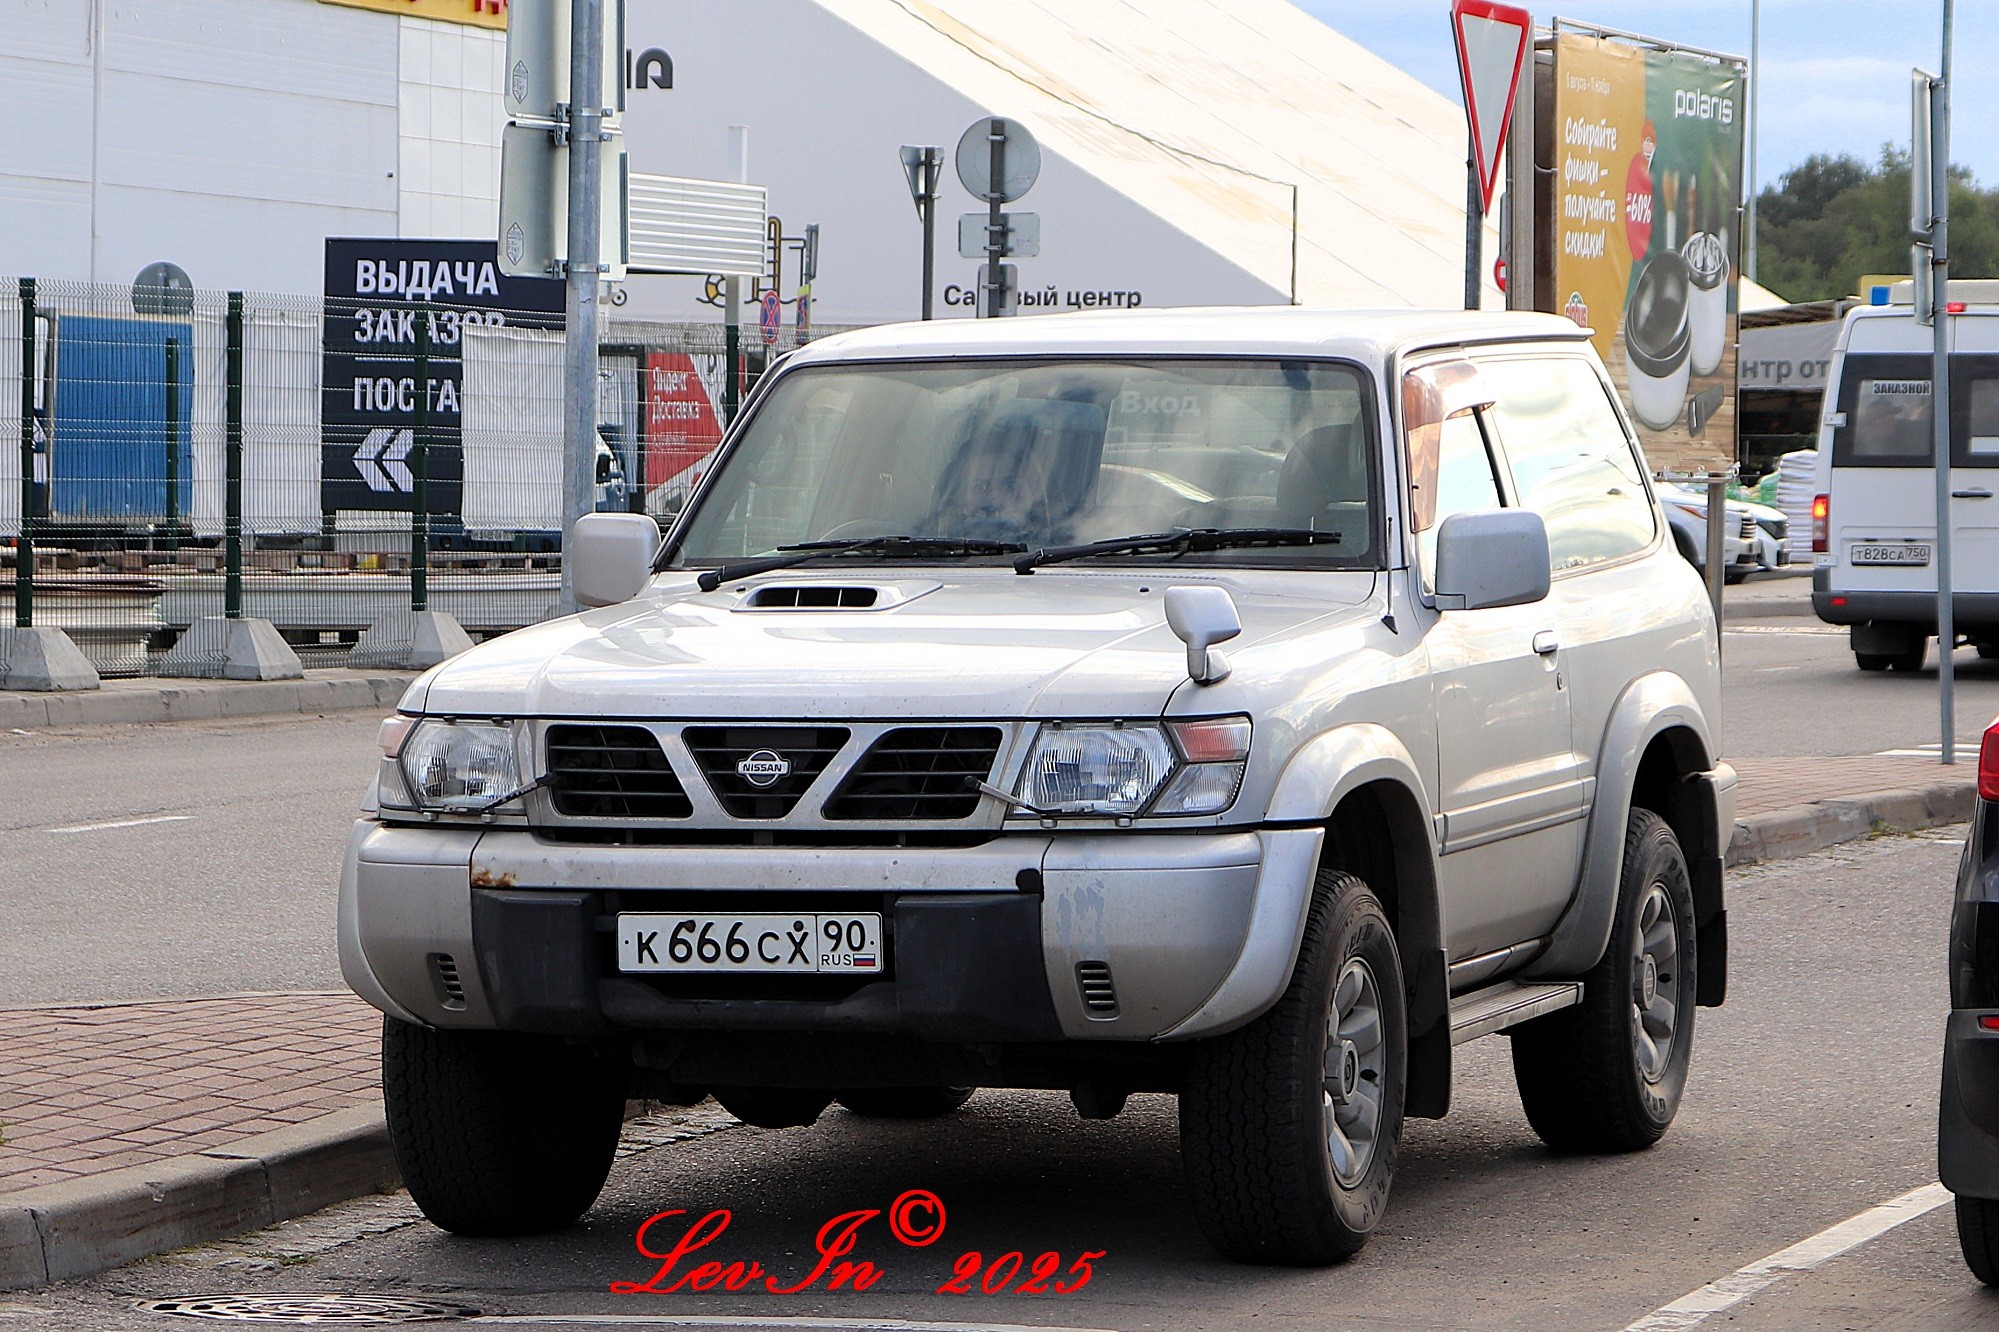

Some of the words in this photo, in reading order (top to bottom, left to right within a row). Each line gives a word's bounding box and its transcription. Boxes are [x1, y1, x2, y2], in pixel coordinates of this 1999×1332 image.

[1675, 88, 1734, 124] polaris
[1565, 116, 1617, 154] Собирайте
[1565, 150, 1599, 188] фишки
[1565, 190, 1616, 226] получайте
[1565, 228, 1606, 260] скидки!
[356, 259, 499, 301] ВЫДАЧА
[944, 284, 1058, 306] Саый
[1066, 290, 1142, 309] центр
[1121, 390, 1201, 416] Вход
[1874, 381, 1930, 394] ЗАКАЗНОЙ
[743, 763, 782, 772] NISSAN
[823, 919, 866, 952] 90
[821, 953, 852, 966] RUS
